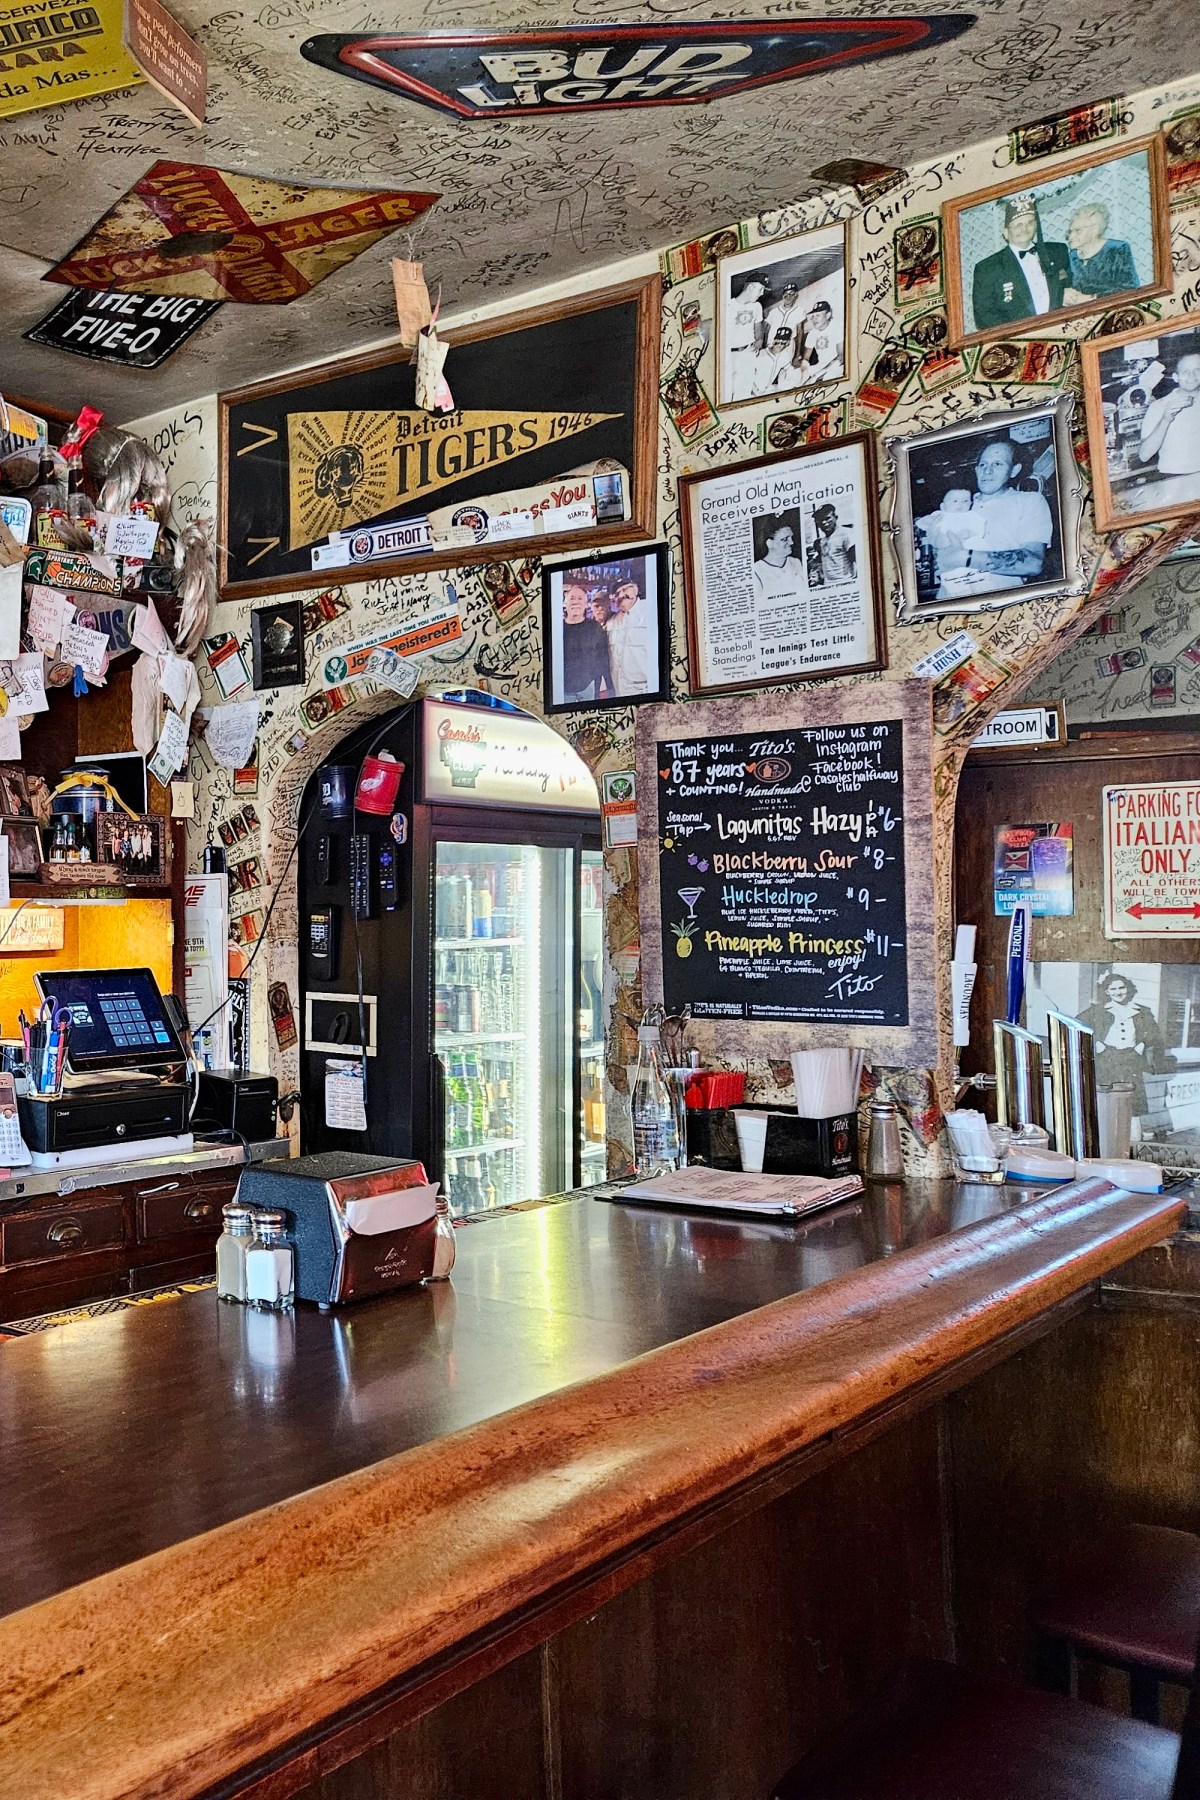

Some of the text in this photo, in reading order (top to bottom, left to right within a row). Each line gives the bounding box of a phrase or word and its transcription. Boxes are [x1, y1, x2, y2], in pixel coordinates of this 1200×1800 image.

[478, 43, 752, 86] BUD
[455, 73, 747, 109] LIGHT
[265, 196, 418, 247] LAGER
[142, 294, 204, 322] BIG
[395, 411, 464, 444] Detroit
[547, 411, 593, 442] 1946
[391, 418, 540, 496] TIGERS
[551, 483, 588, 508] You
[701, 478, 803, 511] Grand Old Man
[701, 482, 855, 526] Receives Dedication
[378, 526, 423, 550] DETROIT
[55, 571, 122, 593] CHAMPIONS
[346, 612, 448, 653] WHEN WAS THE LAST TIME YOU WERE
[777, 641, 808, 655] Innings
[810, 637, 829, 649] Test
[831, 633, 856, 646] Little
[711, 652, 757, 667] Standings
[714, 640, 754, 656] Baseball
[760, 651, 842, 671] League's Endurance
[931, 648, 963, 674] HUSH
[800, 725, 889, 743] Follow us on
[665, 742, 706, 760] Thank
[816, 740, 883, 759] Instagram
[671, 760, 747, 785] 87 years
[836, 781, 862, 794] club
[666, 810, 704, 823] Seasonal
[1116, 792, 1181, 819] PARKING
[665, 823, 695, 838] Tap
[716, 805, 862, 844] Lagunitas Hazy
[1116, 820, 1200, 847] ITALIAN
[712, 849, 859, 875] Blackberry Sour
[1141, 848, 1192, 874] ONLY
[1122, 887, 1168, 897] WILL BE
[1130, 879, 1153, 887] ALL
[720, 884, 819, 910] Huckledrop
[998, 893, 1018, 903] DARK
[704, 930, 865, 958] Pineapple Princess
[1011, 918, 1023, 959] PERONI
[959, 972, 975, 1021] LAGUNITAS
